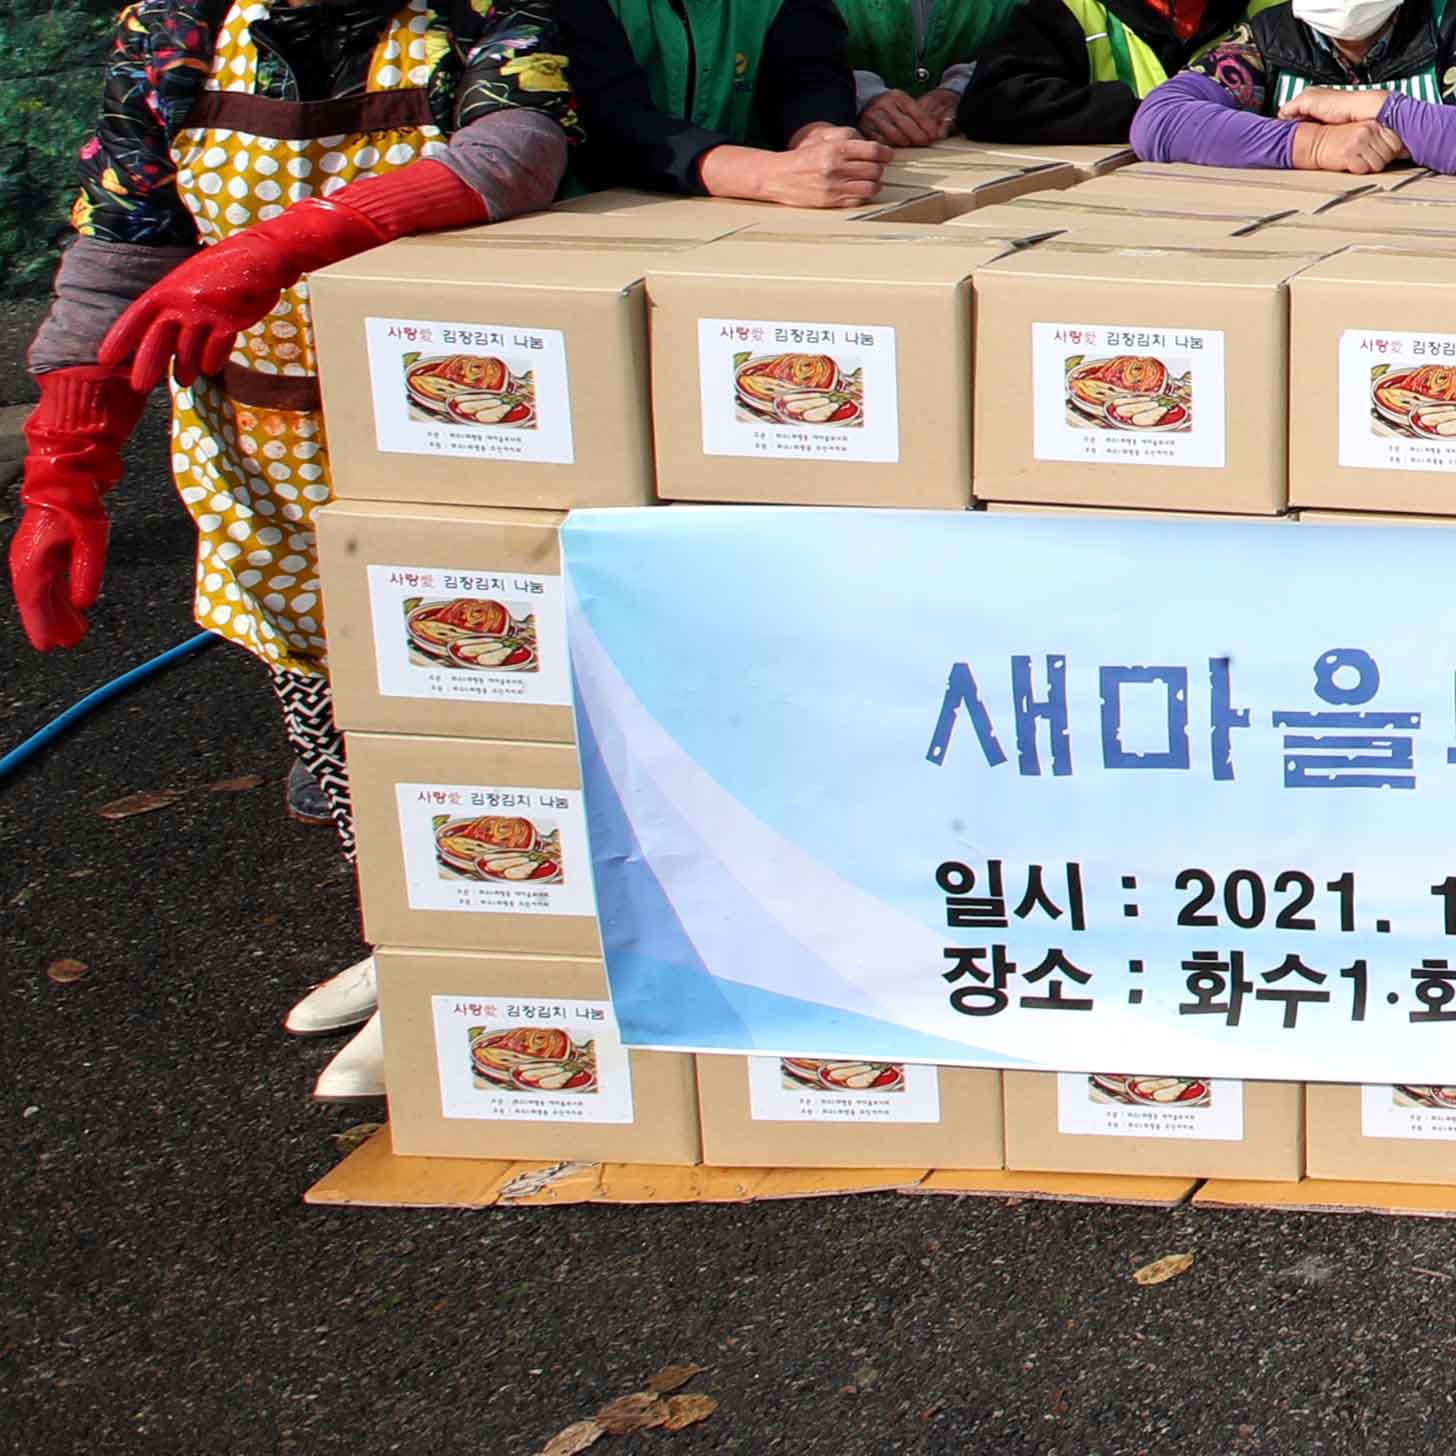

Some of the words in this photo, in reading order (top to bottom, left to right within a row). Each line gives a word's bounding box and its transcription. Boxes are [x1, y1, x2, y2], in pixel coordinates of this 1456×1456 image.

[440, 329, 504, 347] 김장김치
[512, 334, 544, 350] 나눔
[773, 328, 835, 344] 김장김치
[844, 331, 874, 346] 나눔
[1106, 331, 1165, 348] 김장김치
[1174, 335, 1203, 349] 나눔
[442, 575, 505, 592] 김장김치
[513, 579, 544, 594] 나눔
[470, 790, 531, 809] 김장김치
[538, 794, 568, 809] 나눔
[936, 861, 1084, 930] 일시
[943, 945, 1091, 1015] 장소
[507, 1005, 567, 1019] 김장김치
[575, 1007, 604, 1020] 나눔
